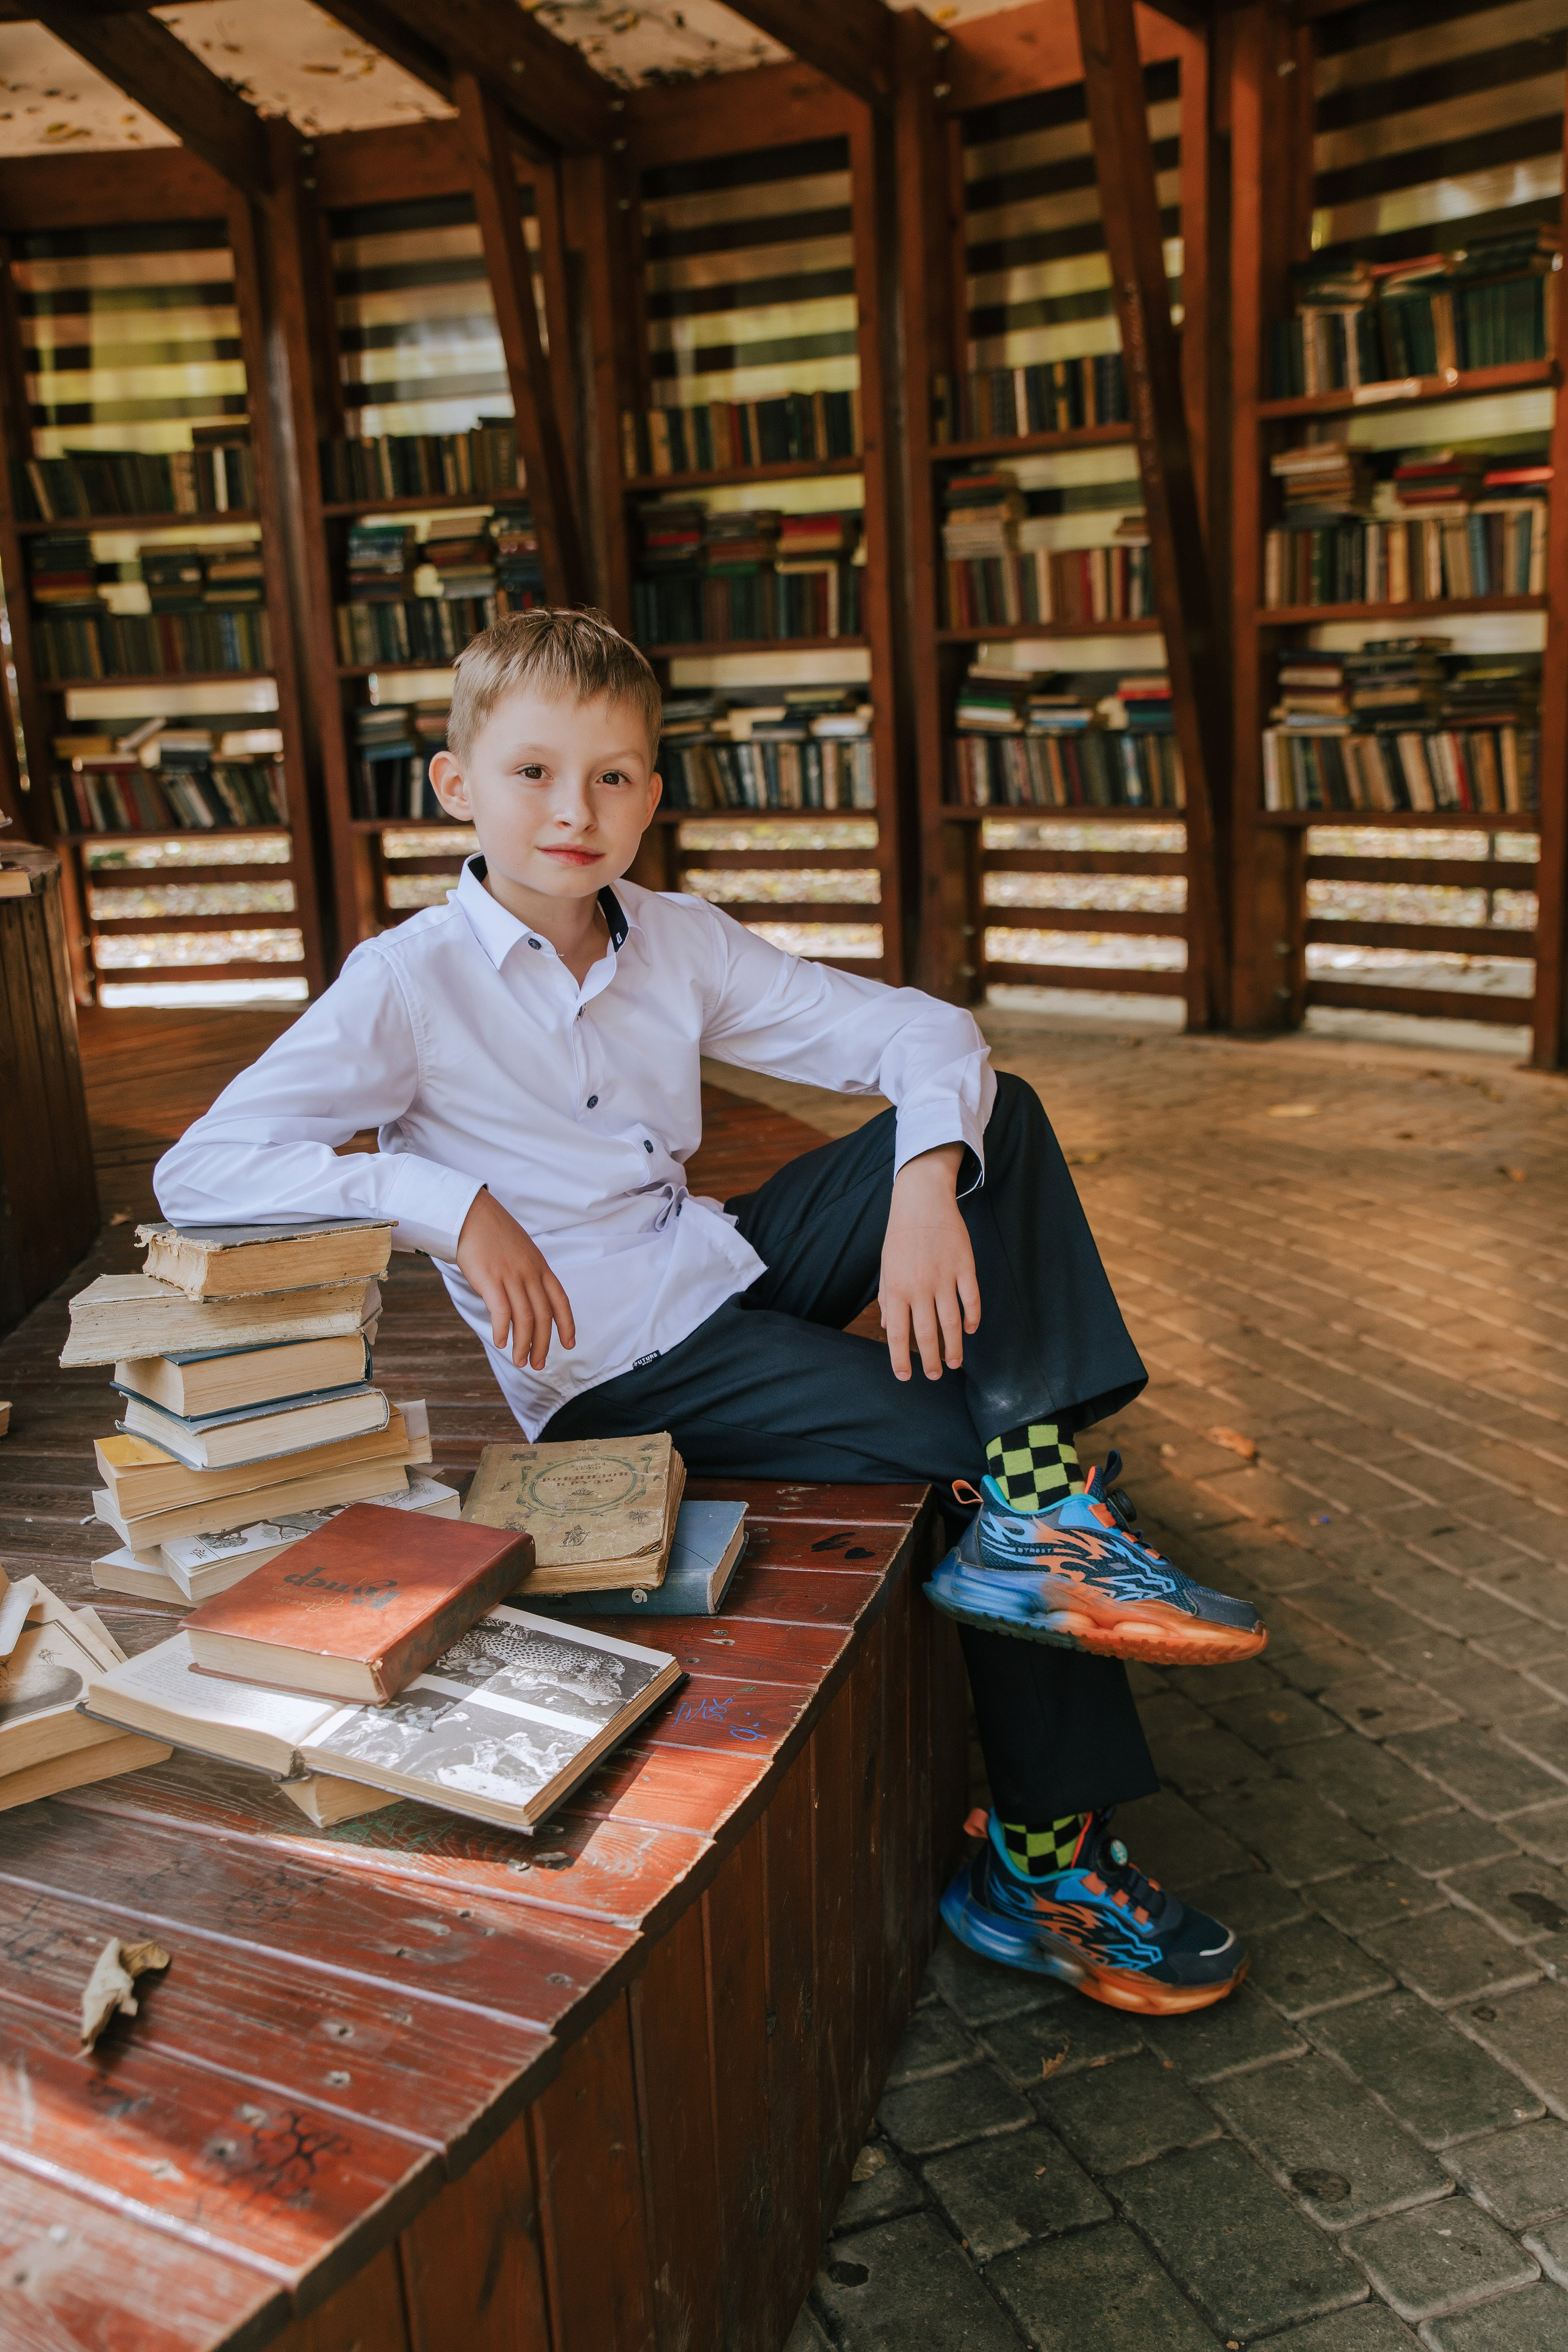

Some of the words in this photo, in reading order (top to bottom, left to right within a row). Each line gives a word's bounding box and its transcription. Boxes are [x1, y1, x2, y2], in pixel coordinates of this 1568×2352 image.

[540, 1471, 628, 1482] РОБИНЗОН
[556, 1478, 614, 1487] КРУЗО
[283, 1566, 404, 1611] Купер
